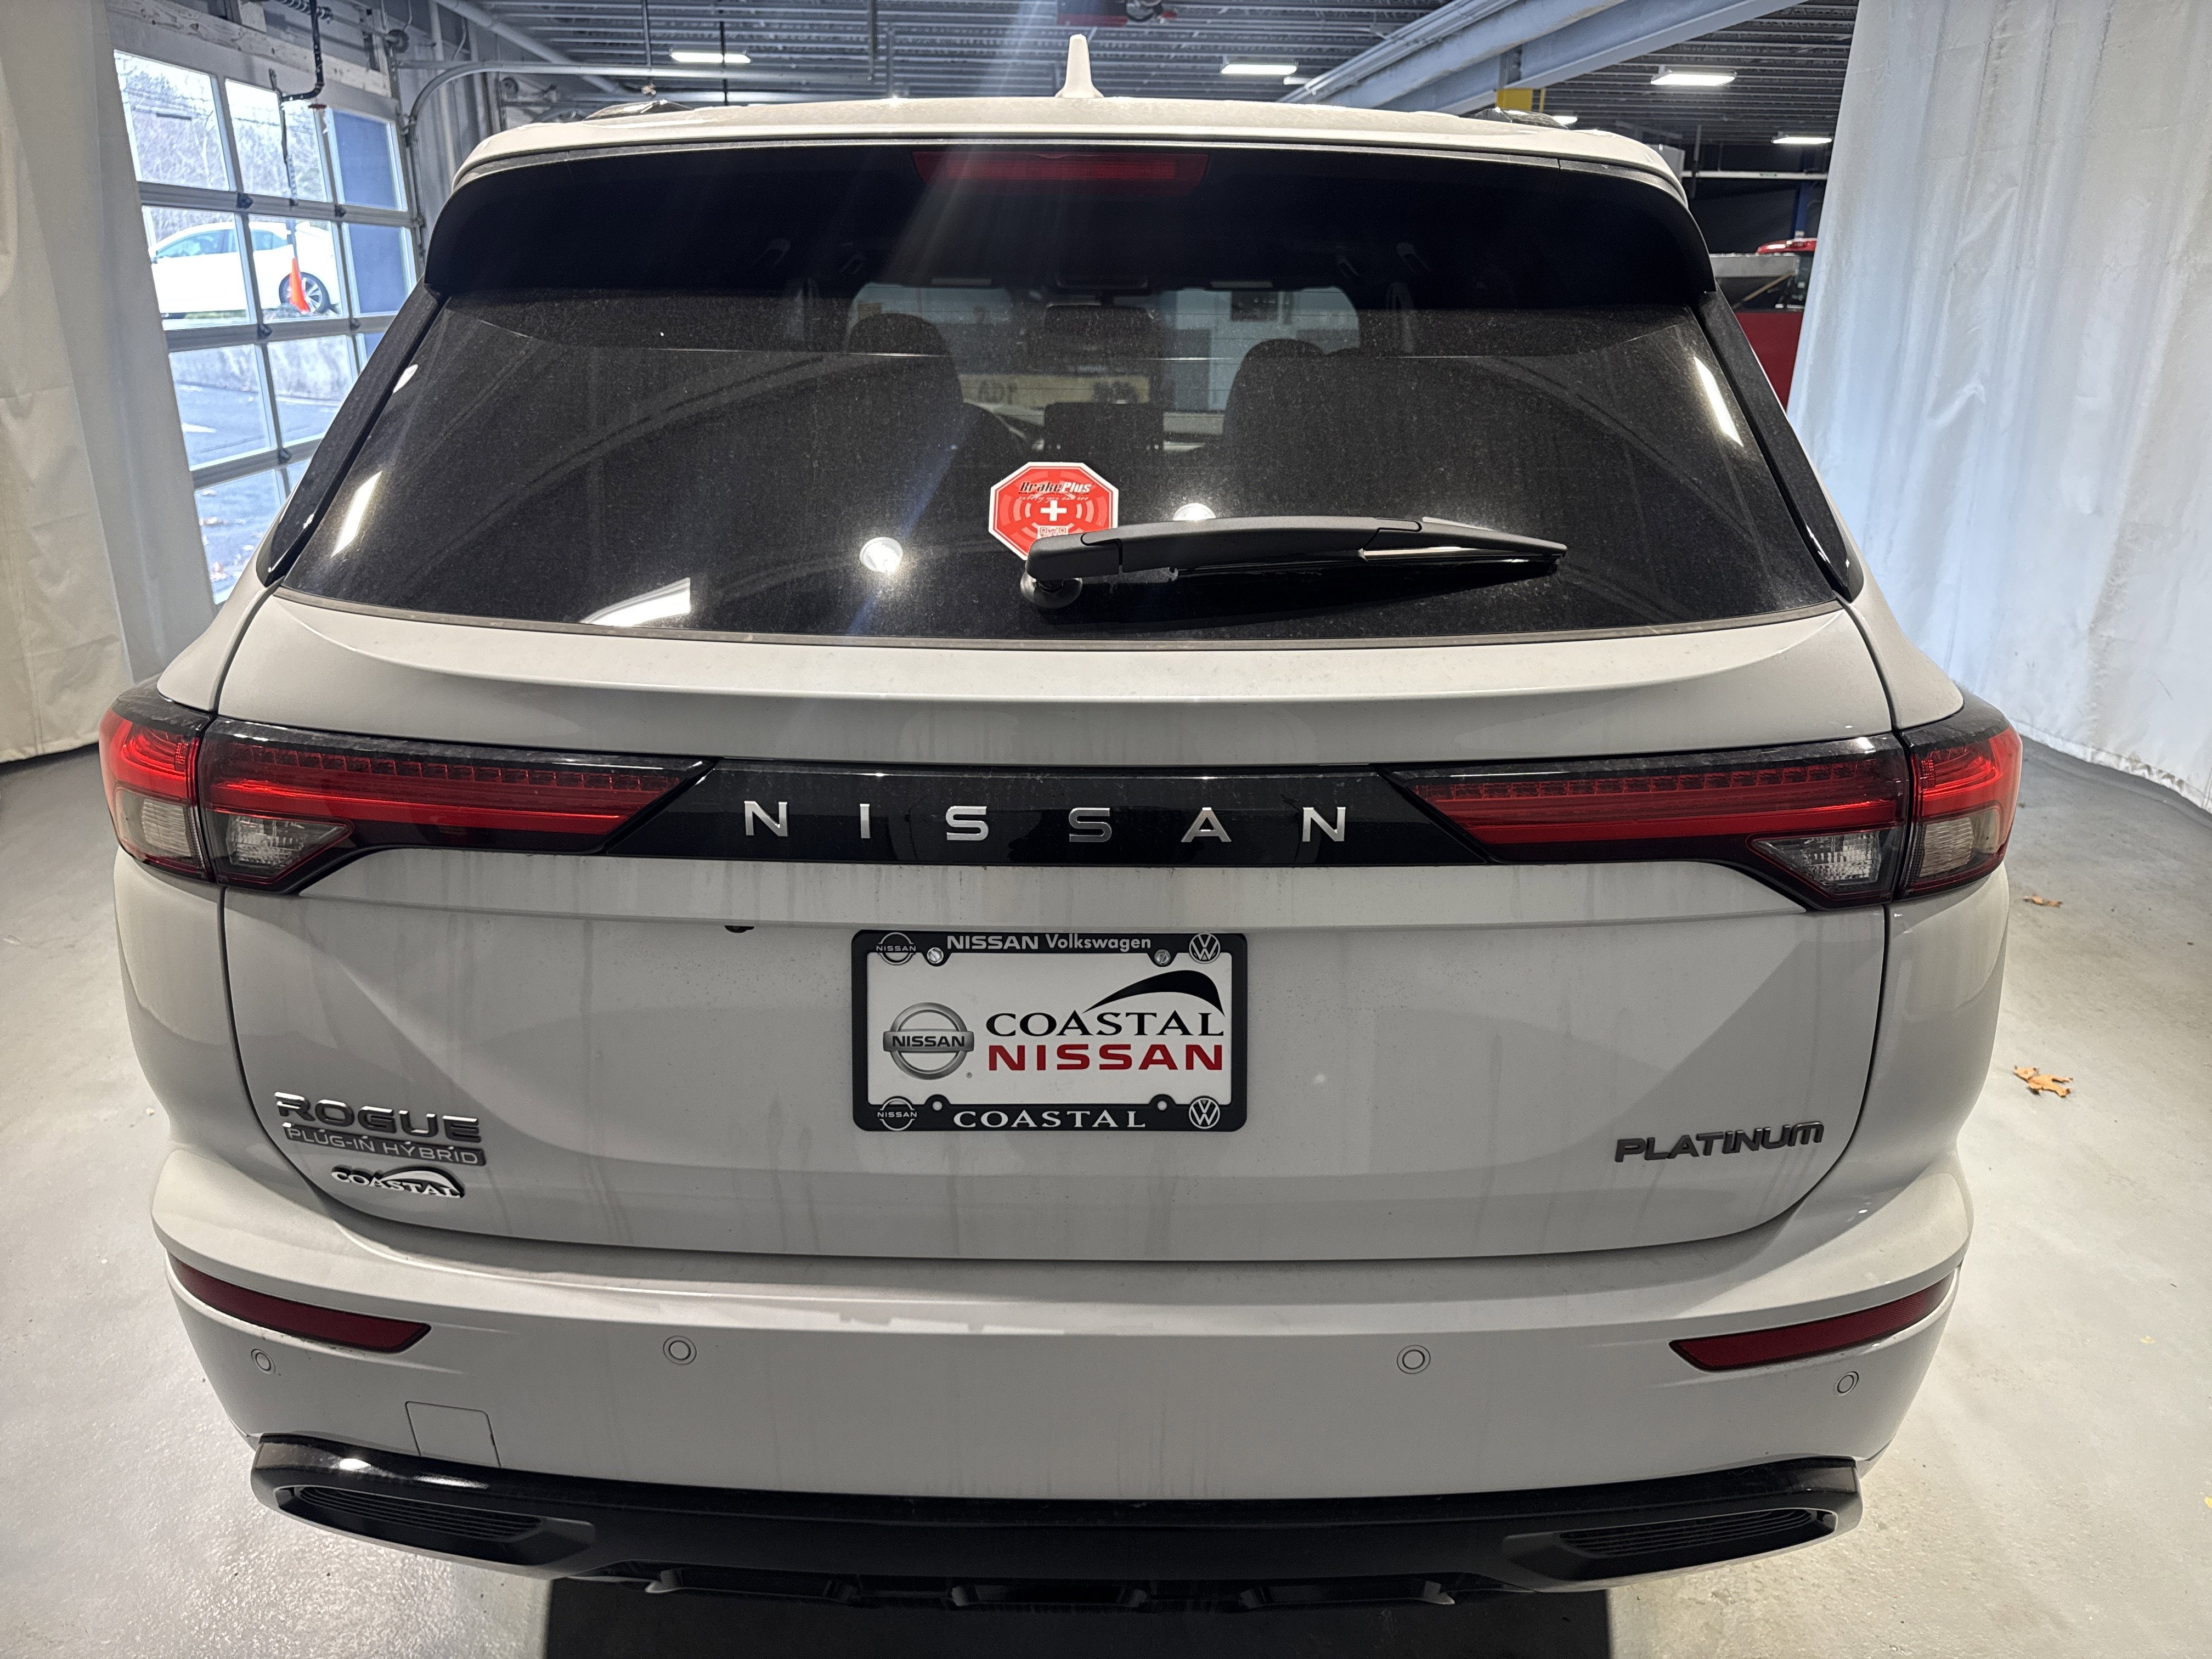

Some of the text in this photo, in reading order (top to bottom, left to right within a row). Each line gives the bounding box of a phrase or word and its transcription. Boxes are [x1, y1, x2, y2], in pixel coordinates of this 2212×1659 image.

[1020, 482, 1093, 493] BrakePlus
[743, 800, 1346, 843] NISSAN
[947, 933, 1151, 952] NISSAN Volkswagen
[986, 1009, 1224, 1037] COASTAL
[892, 1035, 965, 1047] NISSAN
[989, 1043, 1222, 1071] NISSAN
[275, 1091, 482, 1143] ROGUE
[953, 1109, 1146, 1128] COASTAL
[286, 1128, 479, 1165] PLUG-IN HYBRID
[1615, 1121, 1825, 1163] PLATINUM
[331, 1170, 462, 1199] COASTAL
